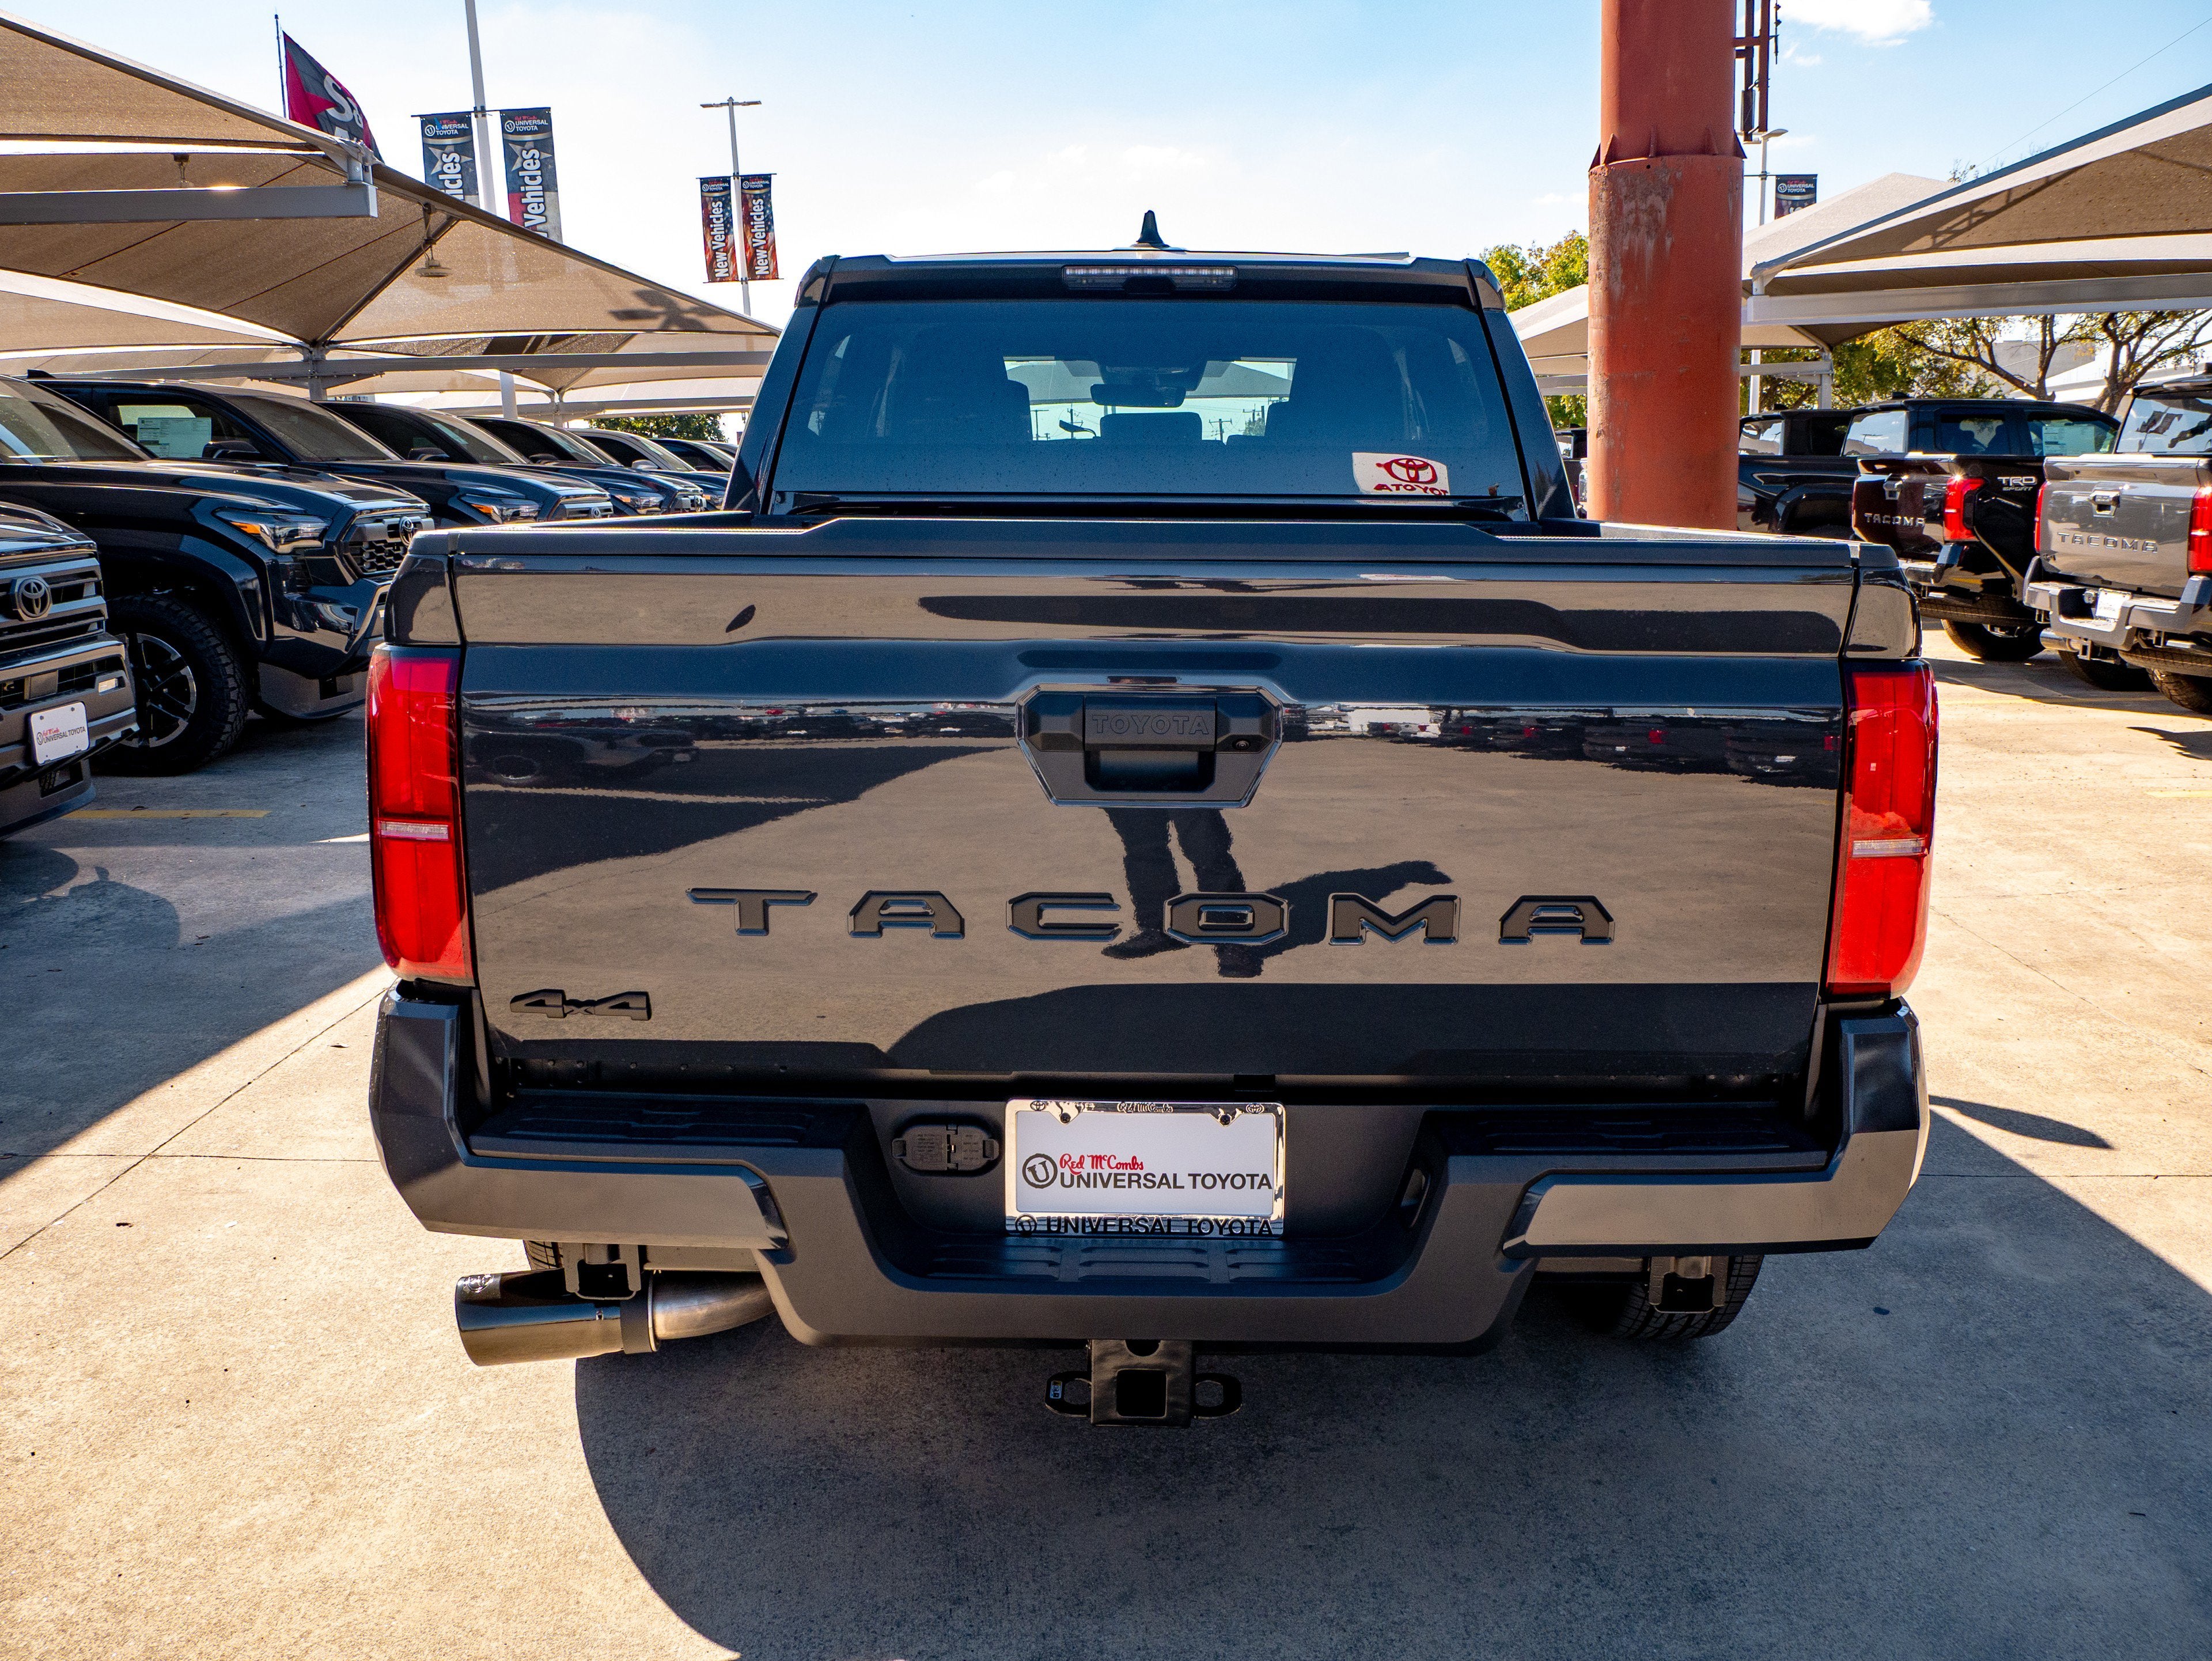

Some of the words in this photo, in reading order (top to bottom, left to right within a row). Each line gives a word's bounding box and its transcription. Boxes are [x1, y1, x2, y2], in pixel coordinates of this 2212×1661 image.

[438, 152, 464, 200] icles
[518, 149, 546, 227] Vehicles
[709, 201, 726, 250] Vehicles
[750, 199, 766, 247] Vehicles
[715, 251, 729, 278] New
[755, 249, 769, 275] New
[1997, 476, 2037, 486] TRD
[1864, 512, 1925, 527] TACOMA
[2058, 532, 2158, 554] TACOMA
[44, 731, 68, 744] UNIVERSAL
[68, 726, 86, 736] TOYOTA
[1092, 714, 1210, 735] TOYOTA
[685, 887, 1616, 945] TACOMA
[510, 988, 652, 1021] 4x4
[1059, 1153, 1085, 1175] Red
[1087, 1155, 1143, 1170] McCombs
[1060, 1172, 1184, 1189] UNIVERSAL
[1188, 1173, 1272, 1190] TOYOTA
[1047, 1216, 1180, 1235] UNIVERSAL
[1183, 1217, 1273, 1236] TOYOTA
